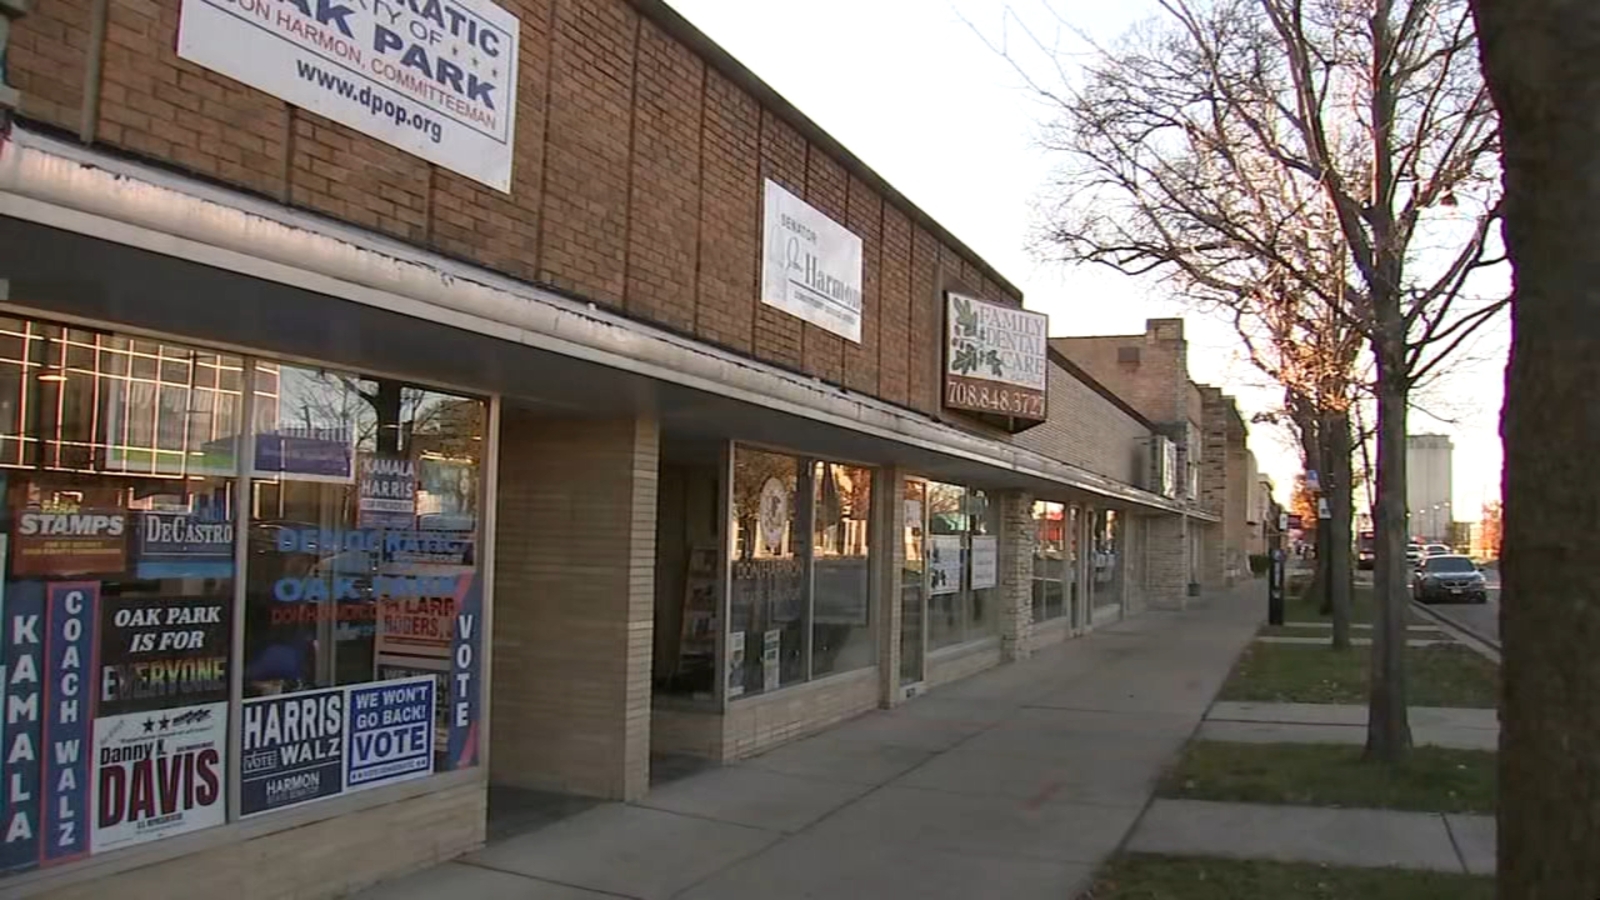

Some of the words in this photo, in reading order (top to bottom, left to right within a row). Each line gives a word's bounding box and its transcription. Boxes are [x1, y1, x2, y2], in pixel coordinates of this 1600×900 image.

[410, 20, 443, 46] OF
[277, 9, 366, 68] HARMON,
[371, 57, 496, 131] COMMITTEEMAN
[374, 23, 496, 111] PARK
[297, 59, 442, 143] www.dpop.org
[981, 305, 1044, 336] FAMILY
[986, 327, 1044, 357] DENTAL
[1001, 350, 1044, 375] CARE
[361, 459, 414, 477] KAMALA
[361, 480, 414, 498] HARRIS
[19, 513, 124, 536] STAMPS
[114, 608, 162, 628] OAK
[165, 606, 221, 625] PARK
[130, 634, 153, 653] IS
[158, 631, 205, 651] FOR
[102, 657, 227, 701] EVERYONE
[456, 614, 474, 727] VOTE
[356, 693, 378, 709] WE
[383, 686, 428, 705] WON'T
[6, 614, 39, 844] KAMALA
[244, 695, 341, 750] HARRIS
[356, 713, 377, 729] GO
[383, 704, 426, 725] BACK!
[100, 741, 154, 765] Danny
[280, 737, 341, 766] WALZ
[356, 726, 426, 761] VOTE
[98, 749, 219, 830] DAVIS
[266, 770, 320, 796] HARMON
